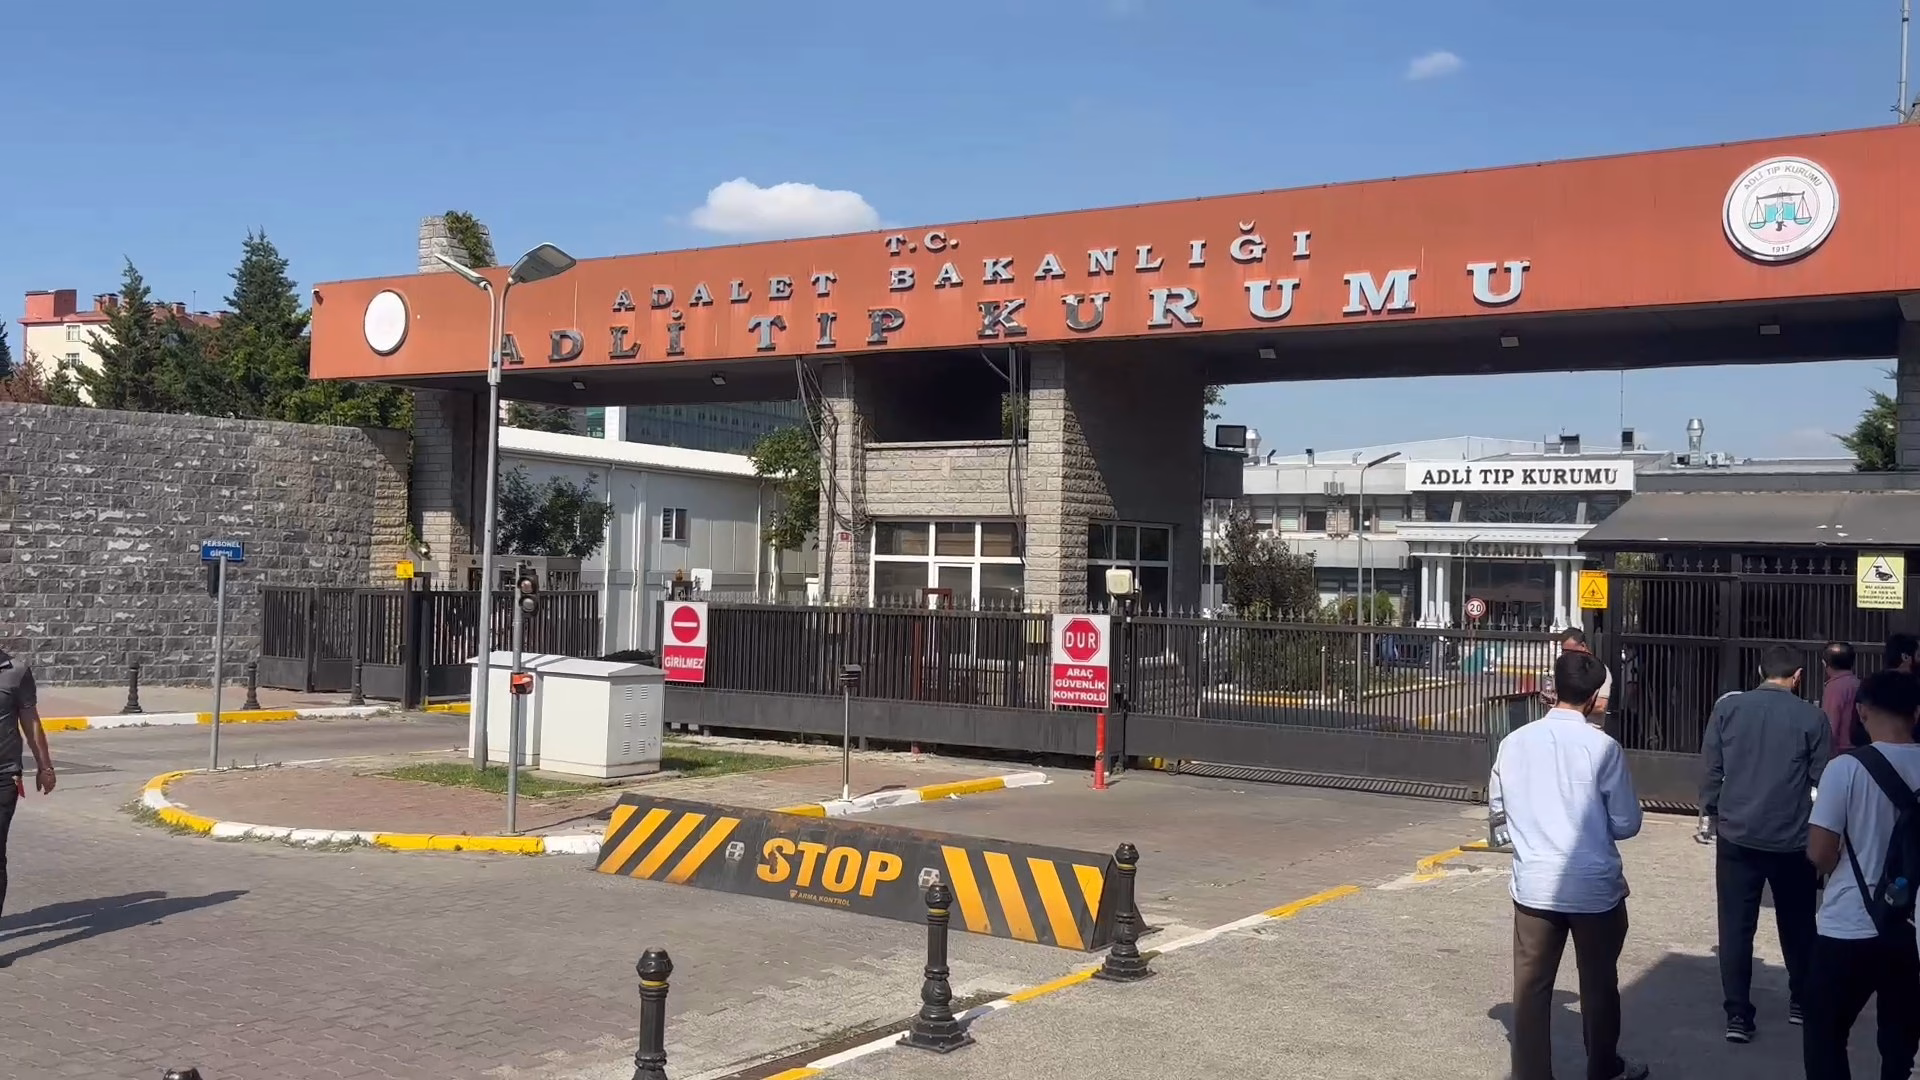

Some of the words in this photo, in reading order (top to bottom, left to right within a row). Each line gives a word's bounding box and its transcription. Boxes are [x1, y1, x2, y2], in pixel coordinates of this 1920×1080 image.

[1744, 171, 1764, 190] ADLİ
[1767, 166, 1781, 176] TIP
[1784, 165, 1823, 187] KURUMU
[885, 231, 960, 257] T.C.
[1772, 245, 1790, 253] 1917
[612, 271, 838, 312] ADALET
[888, 219, 1312, 291] BAKANLIĞI
[493, 310, 686, 367] ADLİ
[748, 307, 906, 352] TIP
[977, 260, 1531, 340] KURUMU
[1421, 466, 1471, 485] ADLİ
[1479, 468, 1514, 485] TIP
[1521, 468, 1618, 485] KURUMU
[202, 540, 241, 548] PERSONEL
[1470, 603, 1482, 613] 20
[1065, 631, 1097, 649] DUR
[664, 655, 704, 669] GİRİLMEZ
[1066, 668, 1094, 679] ARAÇ
[1055, 678, 1105, 690] GÜVENLİK
[1053, 690, 1106, 702] KONTROLÜ
[756, 837, 903, 897] STOP
[798, 892, 817, 901] ARMA
[818, 895, 851, 907] KONTROL
